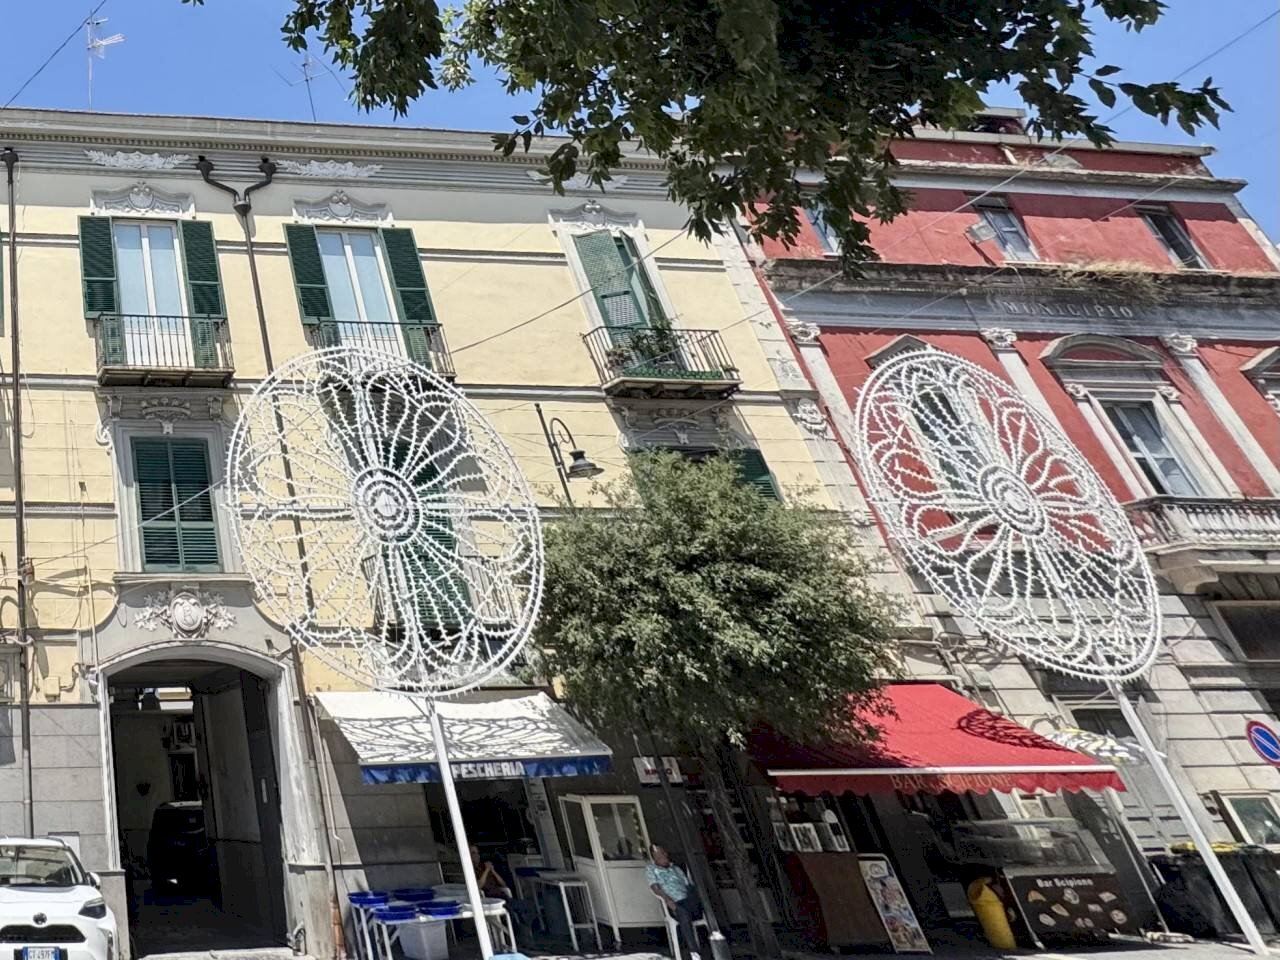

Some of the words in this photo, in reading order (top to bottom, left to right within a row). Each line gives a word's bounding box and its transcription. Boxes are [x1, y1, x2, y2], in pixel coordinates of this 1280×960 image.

[1002, 301, 1134, 318] MUNICIPIO
[451, 761, 526, 779] PESCHERIA
[890, 773, 926, 790] BAR
[1036, 878, 1053, 888] Bar
